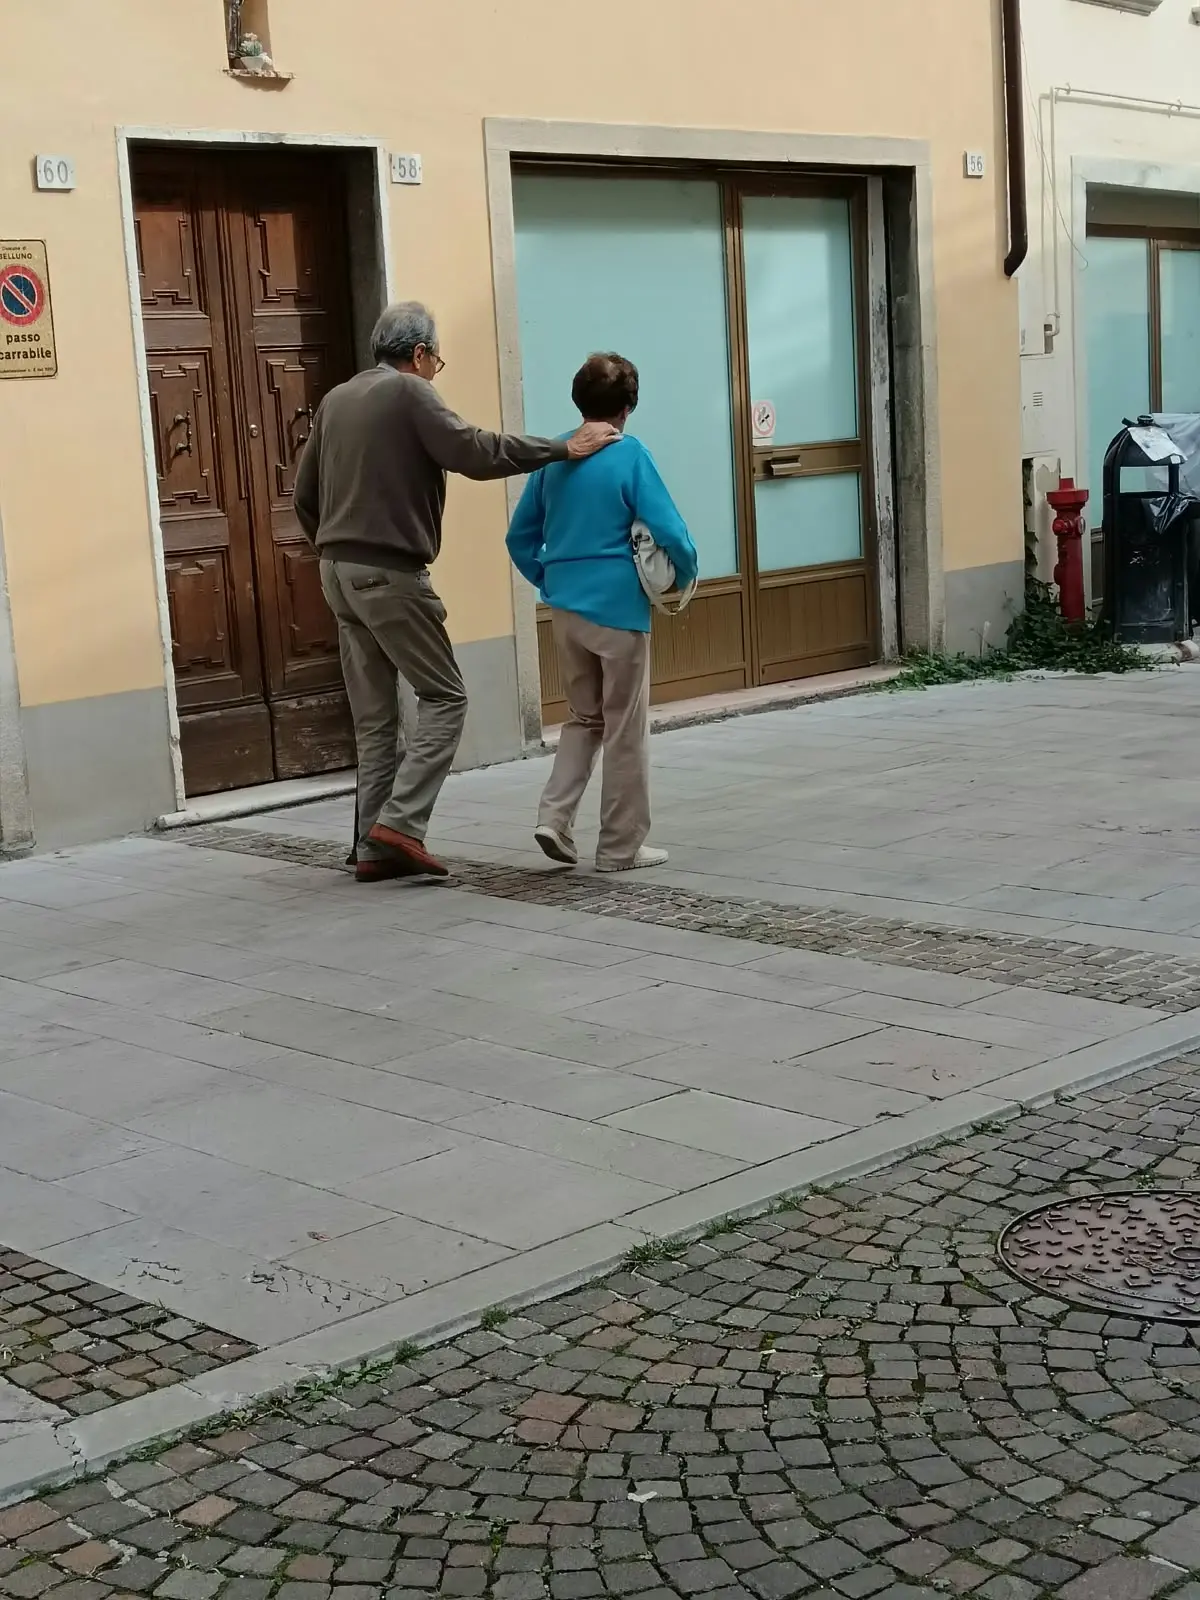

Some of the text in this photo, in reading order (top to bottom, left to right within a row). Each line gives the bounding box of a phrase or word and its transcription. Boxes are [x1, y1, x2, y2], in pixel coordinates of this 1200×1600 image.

[43, 159, 69, 184] 60
[398, 157, 418, 178] 58
[970, 155, 983, 172] 56
[6, 333, 41, 346] passo
[0, 347, 52, 360] carrabile
